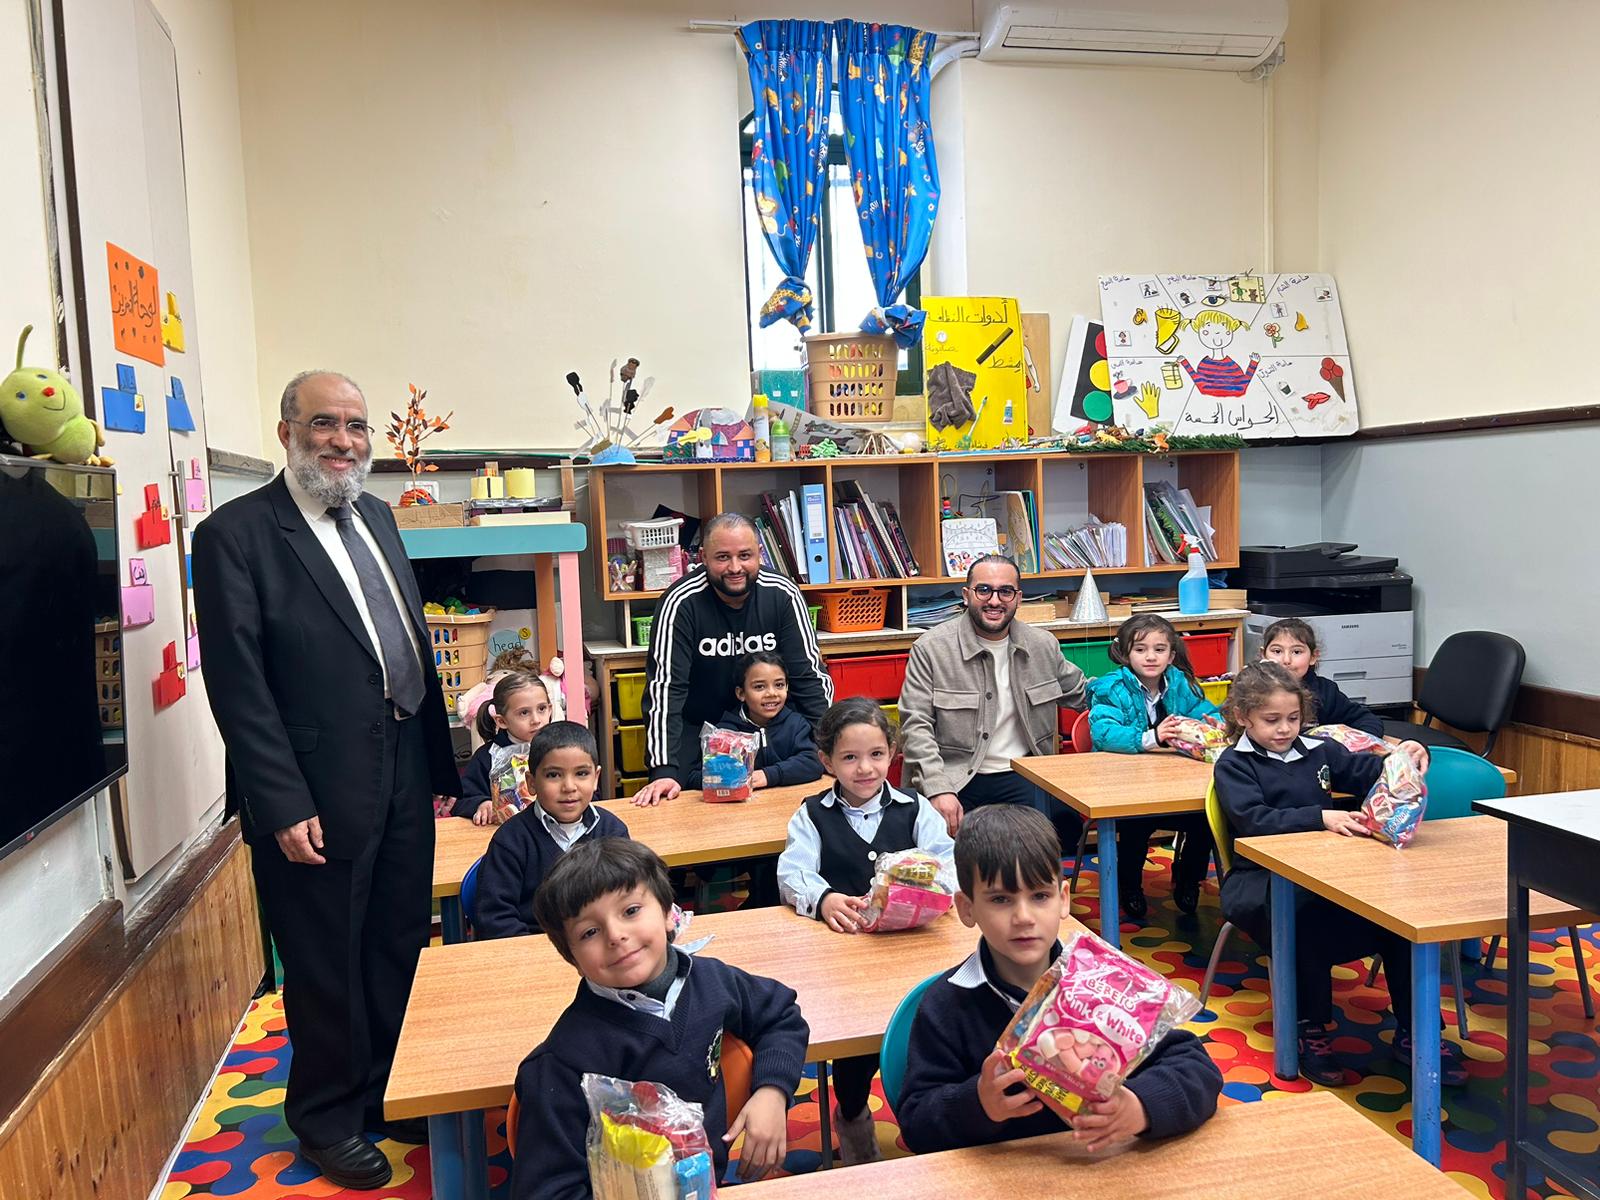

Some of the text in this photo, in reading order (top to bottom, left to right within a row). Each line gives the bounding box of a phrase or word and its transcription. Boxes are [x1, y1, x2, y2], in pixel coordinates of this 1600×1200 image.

[1184, 401, 1279, 431] الحواس الخمسة
[492, 635, 522, 652] head
[698, 631, 777, 657] adidas
[1105, 1010, 1144, 1045] White
